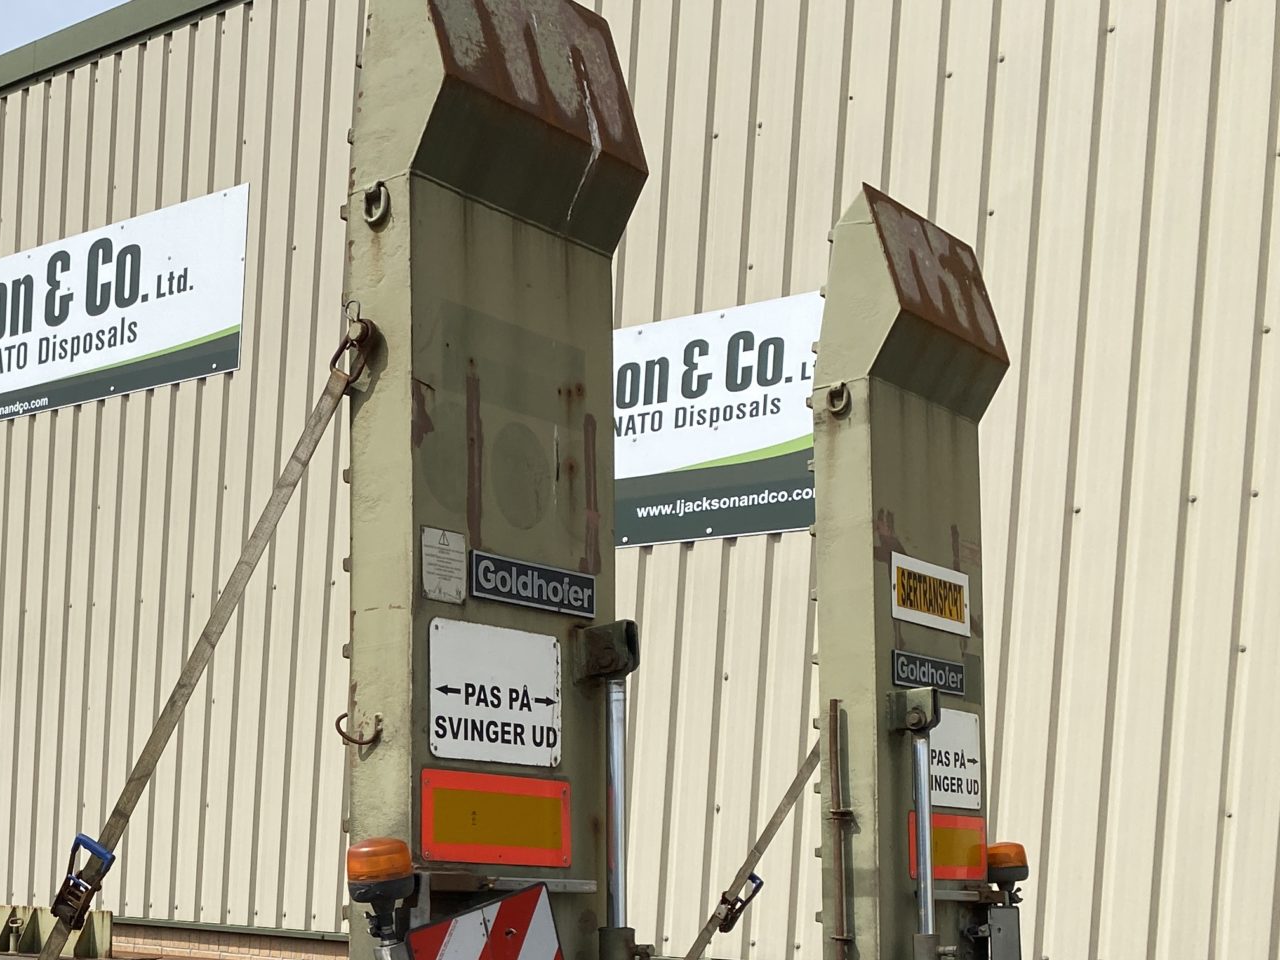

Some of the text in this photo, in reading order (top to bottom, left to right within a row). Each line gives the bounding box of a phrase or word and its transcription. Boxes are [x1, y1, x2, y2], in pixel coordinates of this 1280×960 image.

[44, 250, 74, 327] &
[85, 237, 149, 317] Co.
[156, 267, 194, 299] Ltd.
[37, 317, 138, 365] Disposals
[680, 338, 713, 400] &
[725, 330, 793, 393] Co.
[801, 360, 816, 381] L
[674, 393, 782, 429] Disposals
[477, 559, 592, 608] Goldhofer
[897, 656, 963, 689] Goldhofer
[463, 682, 533, 712] PAS PÅ
[434, 715, 558, 749] SVINGER UD
[930, 748, 967, 769] PAS PÅ
[966, 778, 980, 796] UD
